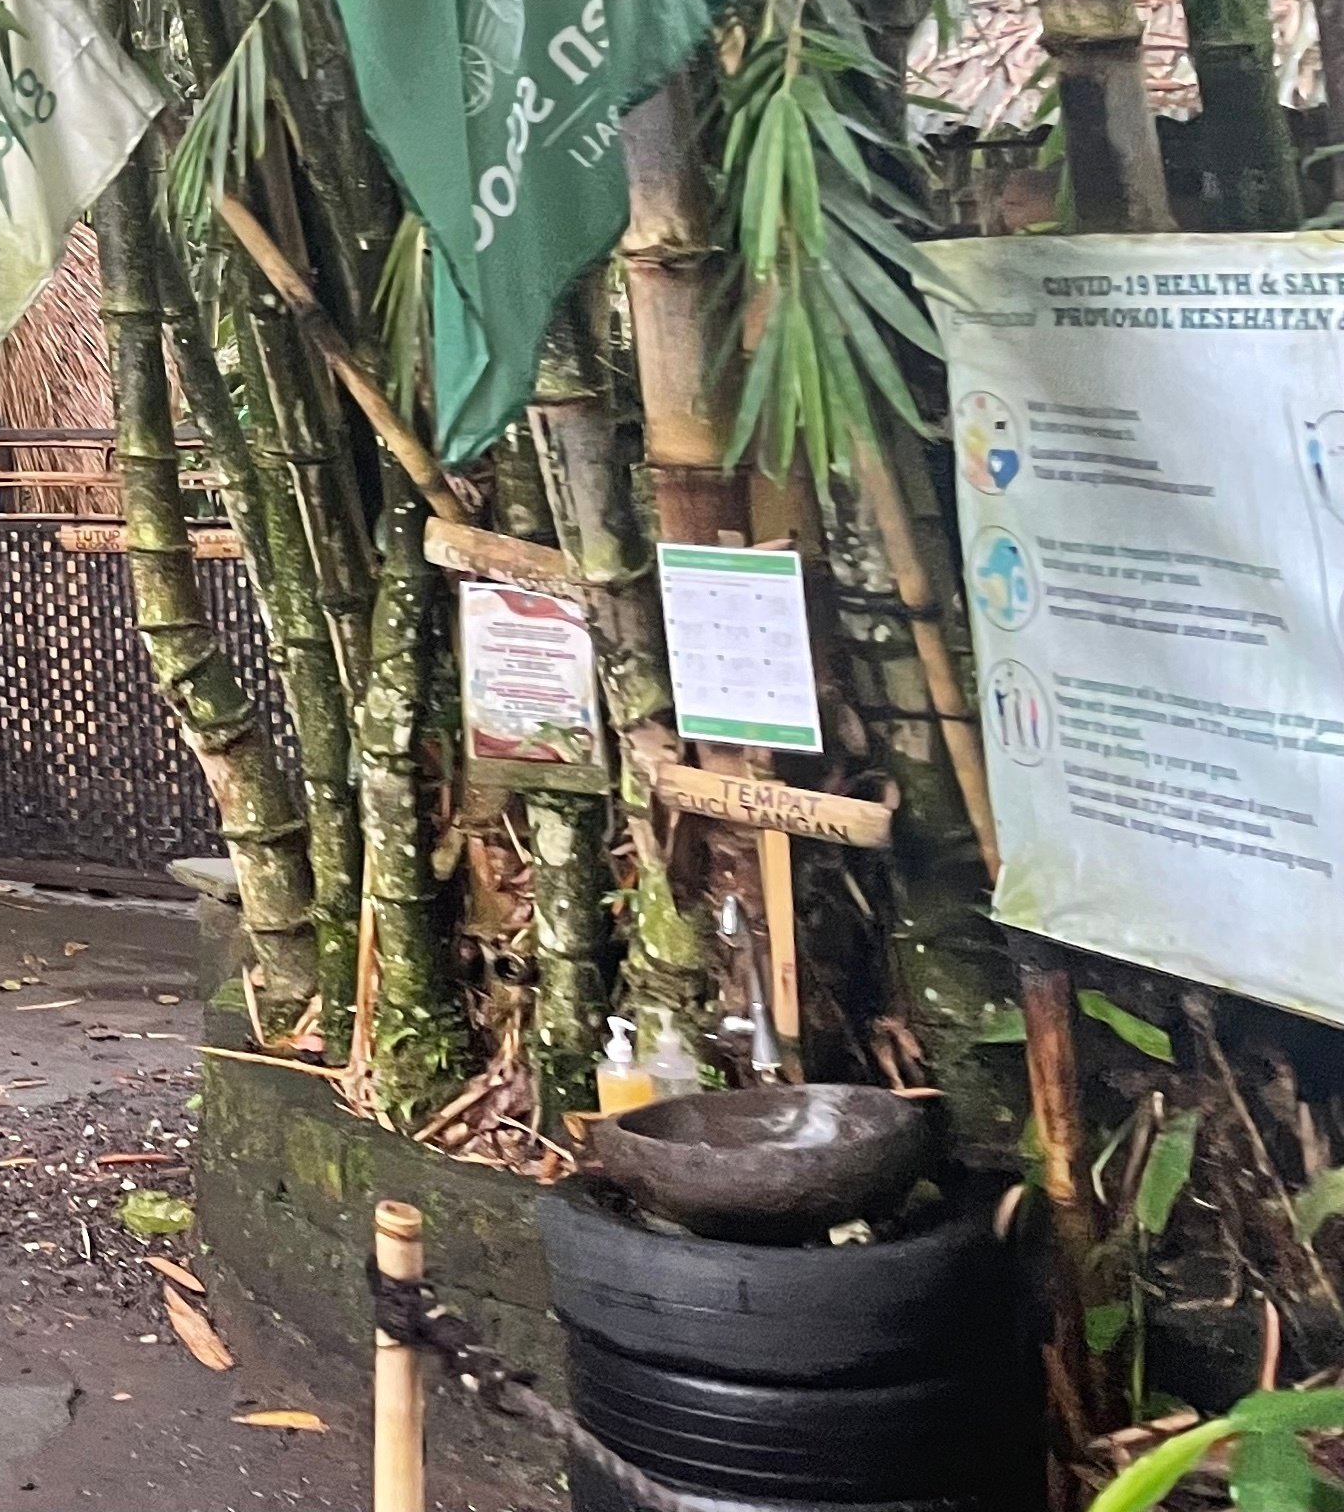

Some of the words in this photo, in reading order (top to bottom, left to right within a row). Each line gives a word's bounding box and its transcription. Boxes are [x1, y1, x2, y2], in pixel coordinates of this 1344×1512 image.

[1155, 273, 1252, 296] HEALTH
[1259, 274, 1280, 296] &
[1180, 307, 1332, 330] KESEHATAN
[719, 778, 823, 816] TEMPAT
[675, 791, 730, 819] CUCI
[739, 804, 853, 844] TANGAN
